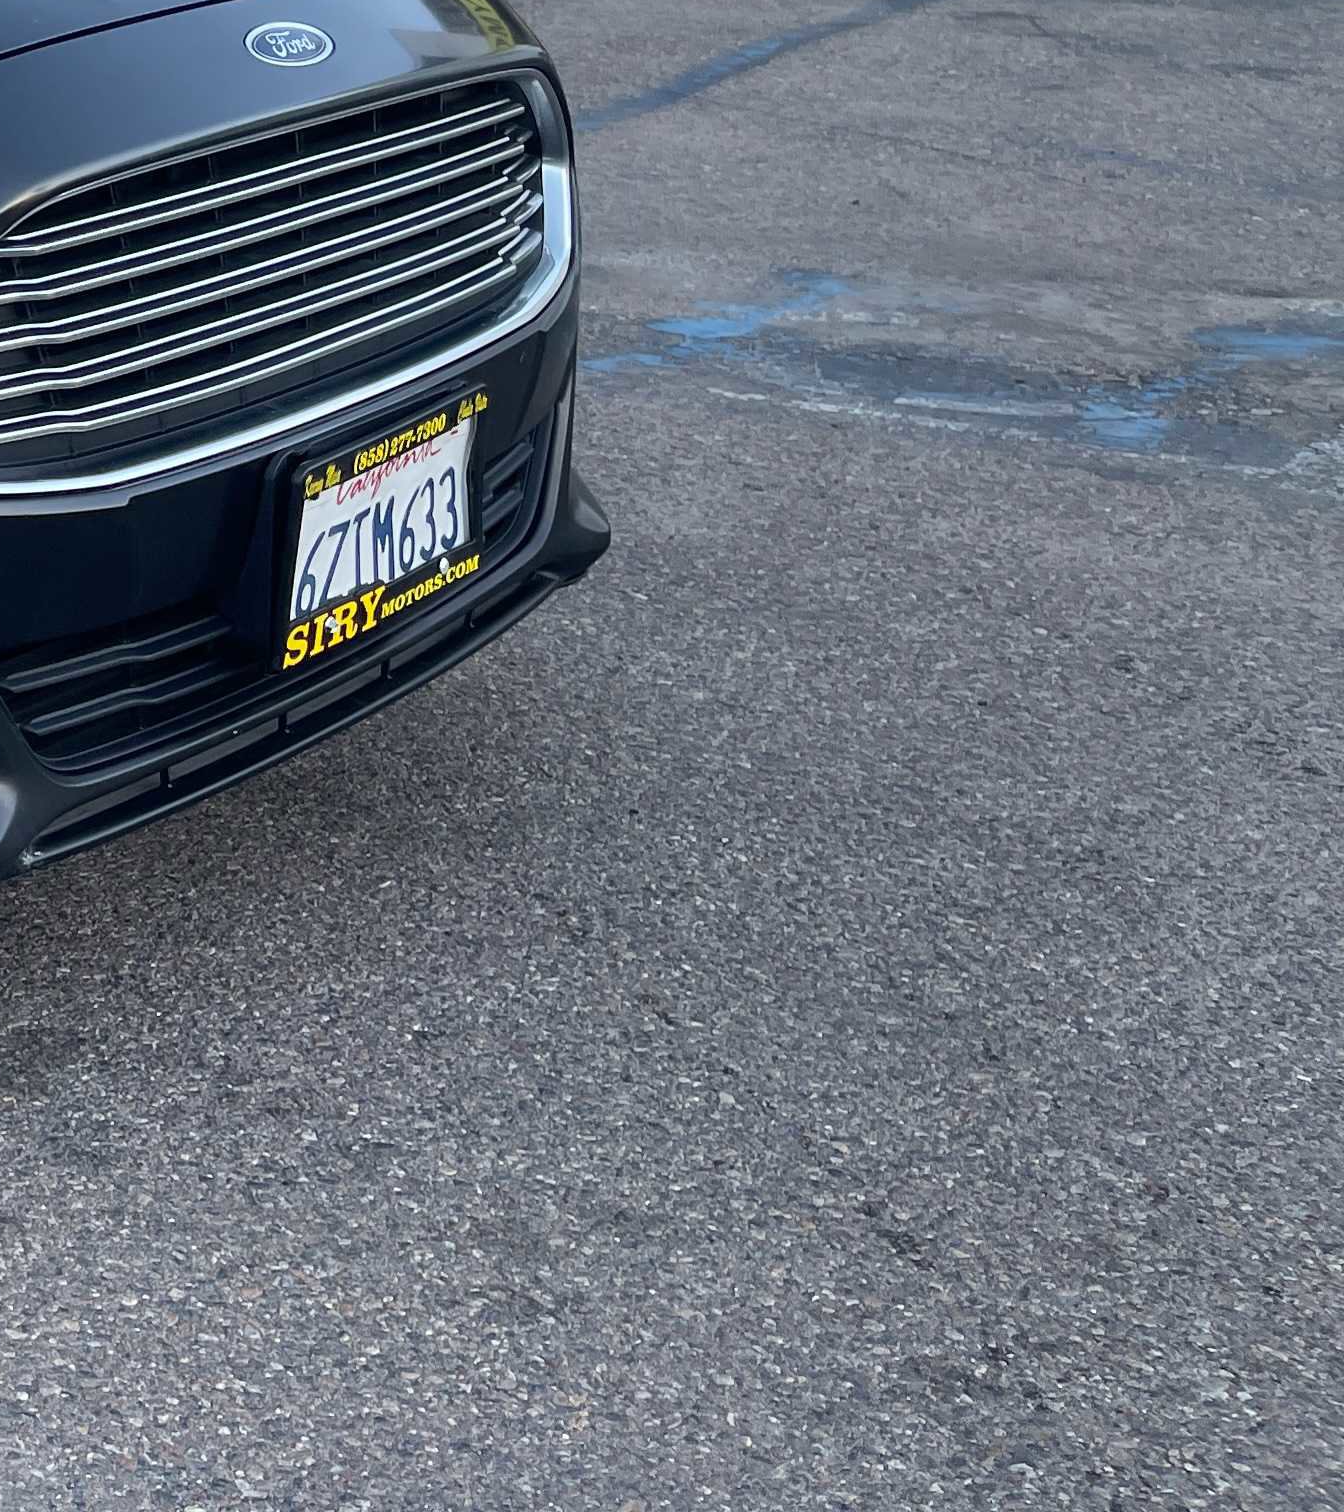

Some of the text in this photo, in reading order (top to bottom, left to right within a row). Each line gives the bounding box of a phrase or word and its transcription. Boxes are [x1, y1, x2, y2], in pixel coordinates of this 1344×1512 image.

[265, 30, 316, 57] Ford
[283, 554, 480, 670] SIRY MOTORS.COM
